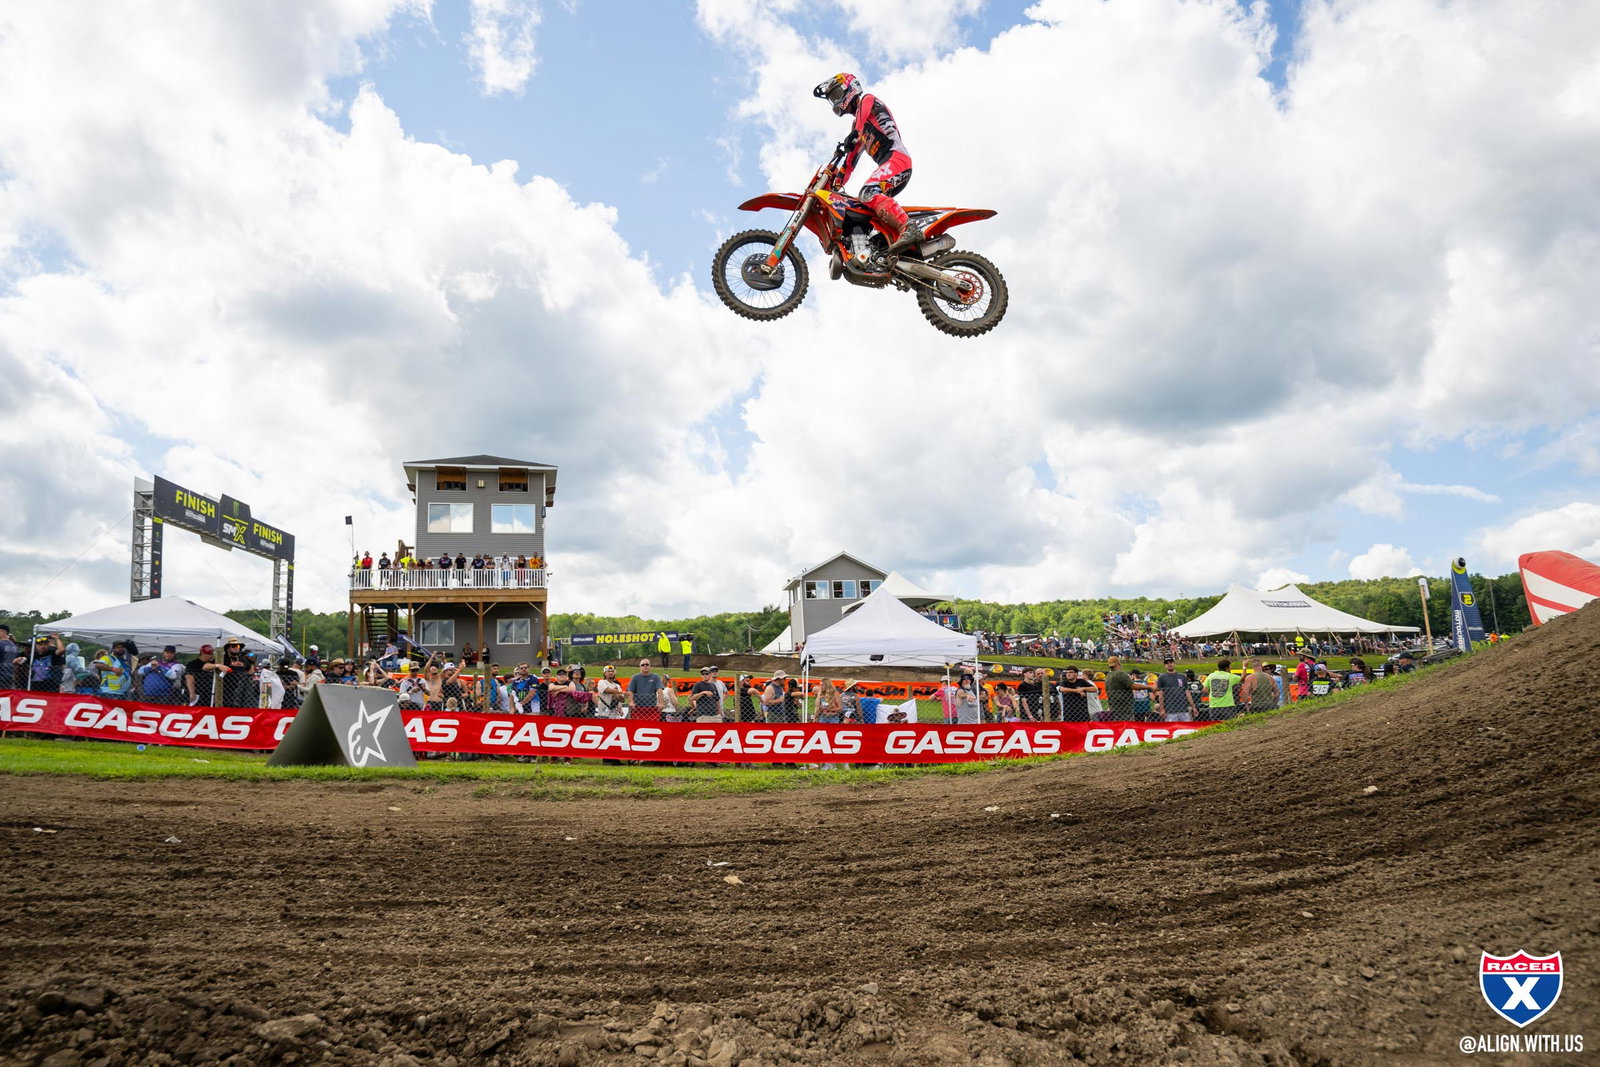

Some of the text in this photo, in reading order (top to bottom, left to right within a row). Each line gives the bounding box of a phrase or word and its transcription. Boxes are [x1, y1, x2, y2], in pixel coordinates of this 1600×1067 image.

[175, 490, 215, 518] FINISH
[222, 522, 247, 545] SMX
[253, 523, 283, 545] FINISH
[595, 633, 655, 644] HOLESHOT
[64, 702, 253, 740] GASGAS
[480, 720, 661, 751] GASGAS
[684, 730, 862, 754] GASGAS
[885, 730, 1061, 754] GASGAS
